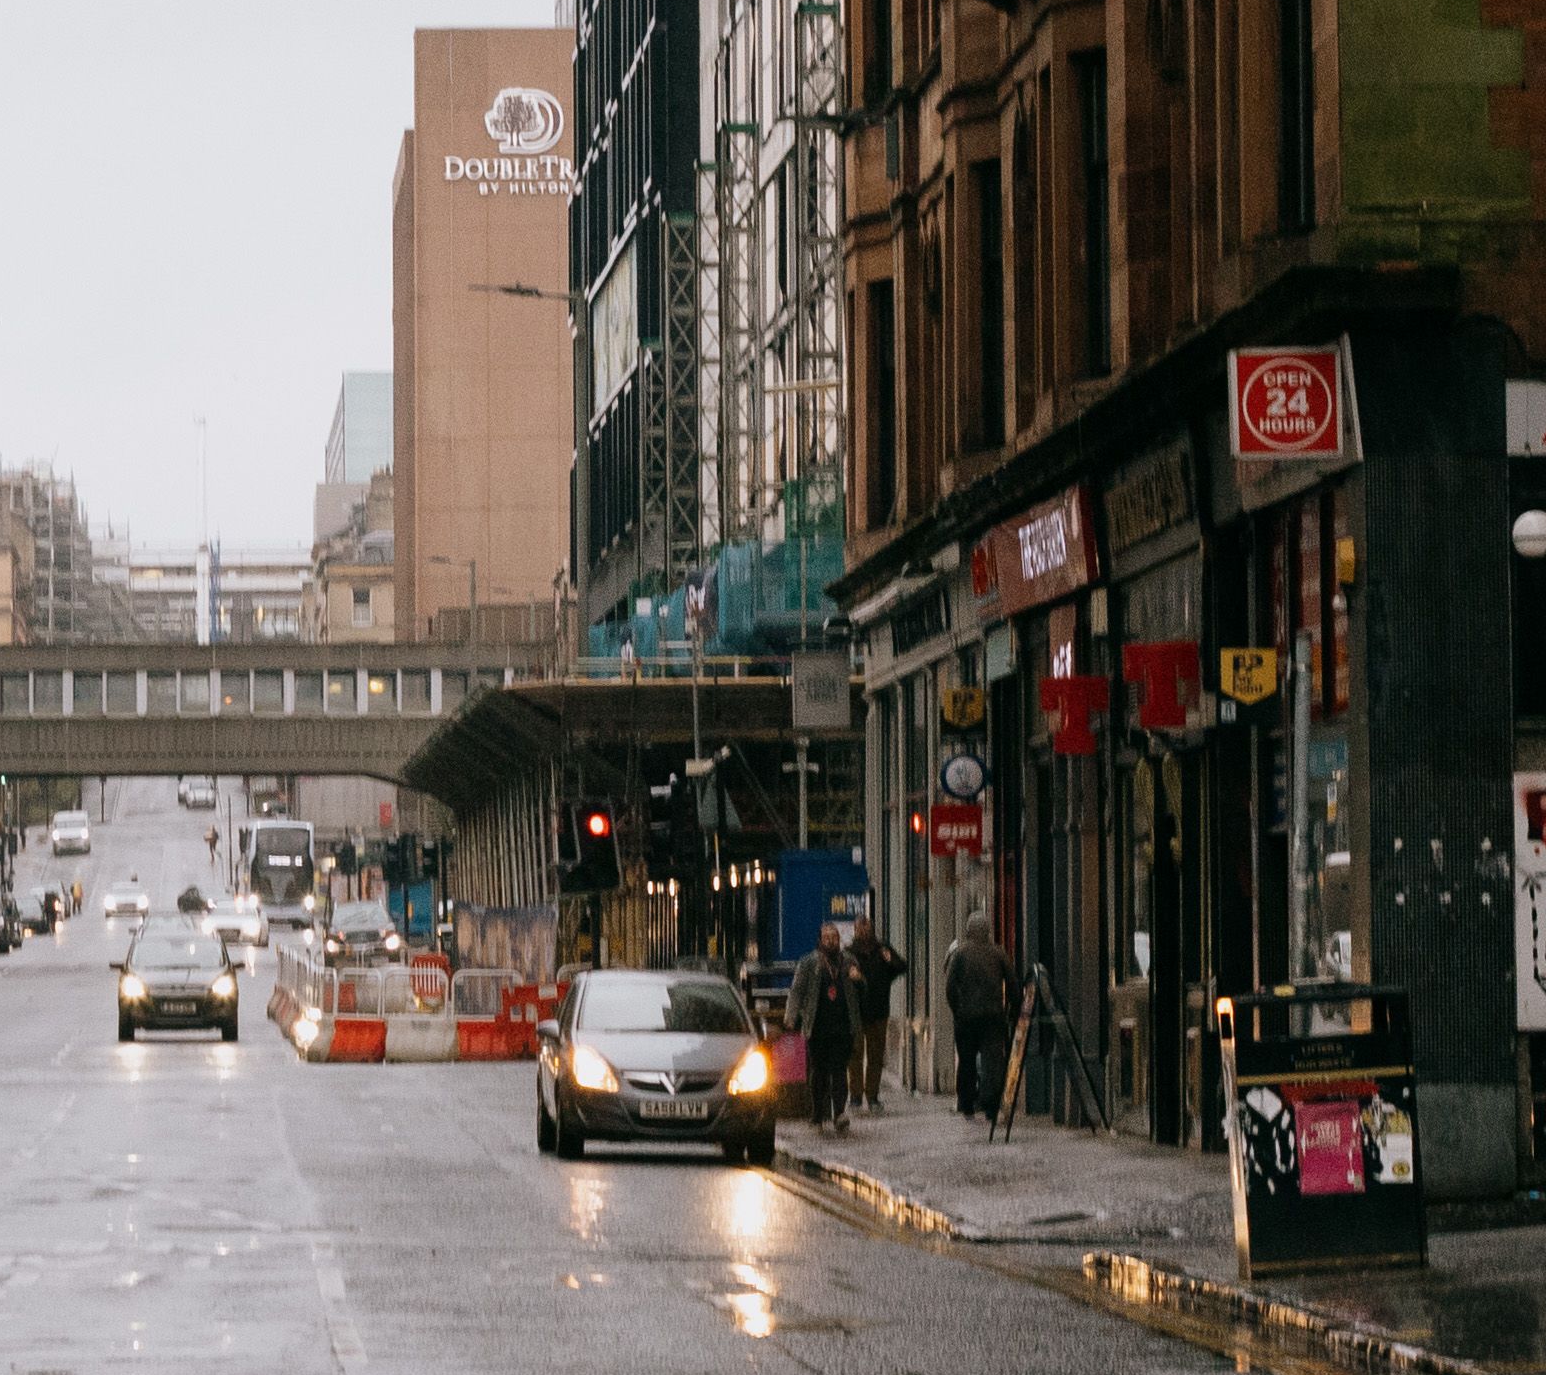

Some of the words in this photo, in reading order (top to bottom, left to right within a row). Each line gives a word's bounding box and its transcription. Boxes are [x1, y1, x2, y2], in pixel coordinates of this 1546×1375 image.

[444, 155, 574, 181] DOUBLETR
[478, 181, 499, 196] BY
[509, 181, 571, 195] HILTON
[1263, 371, 1312, 388] OPEN
[1266, 388, 1310, 417] 24
[1259, 416, 1316, 434] HOURS
